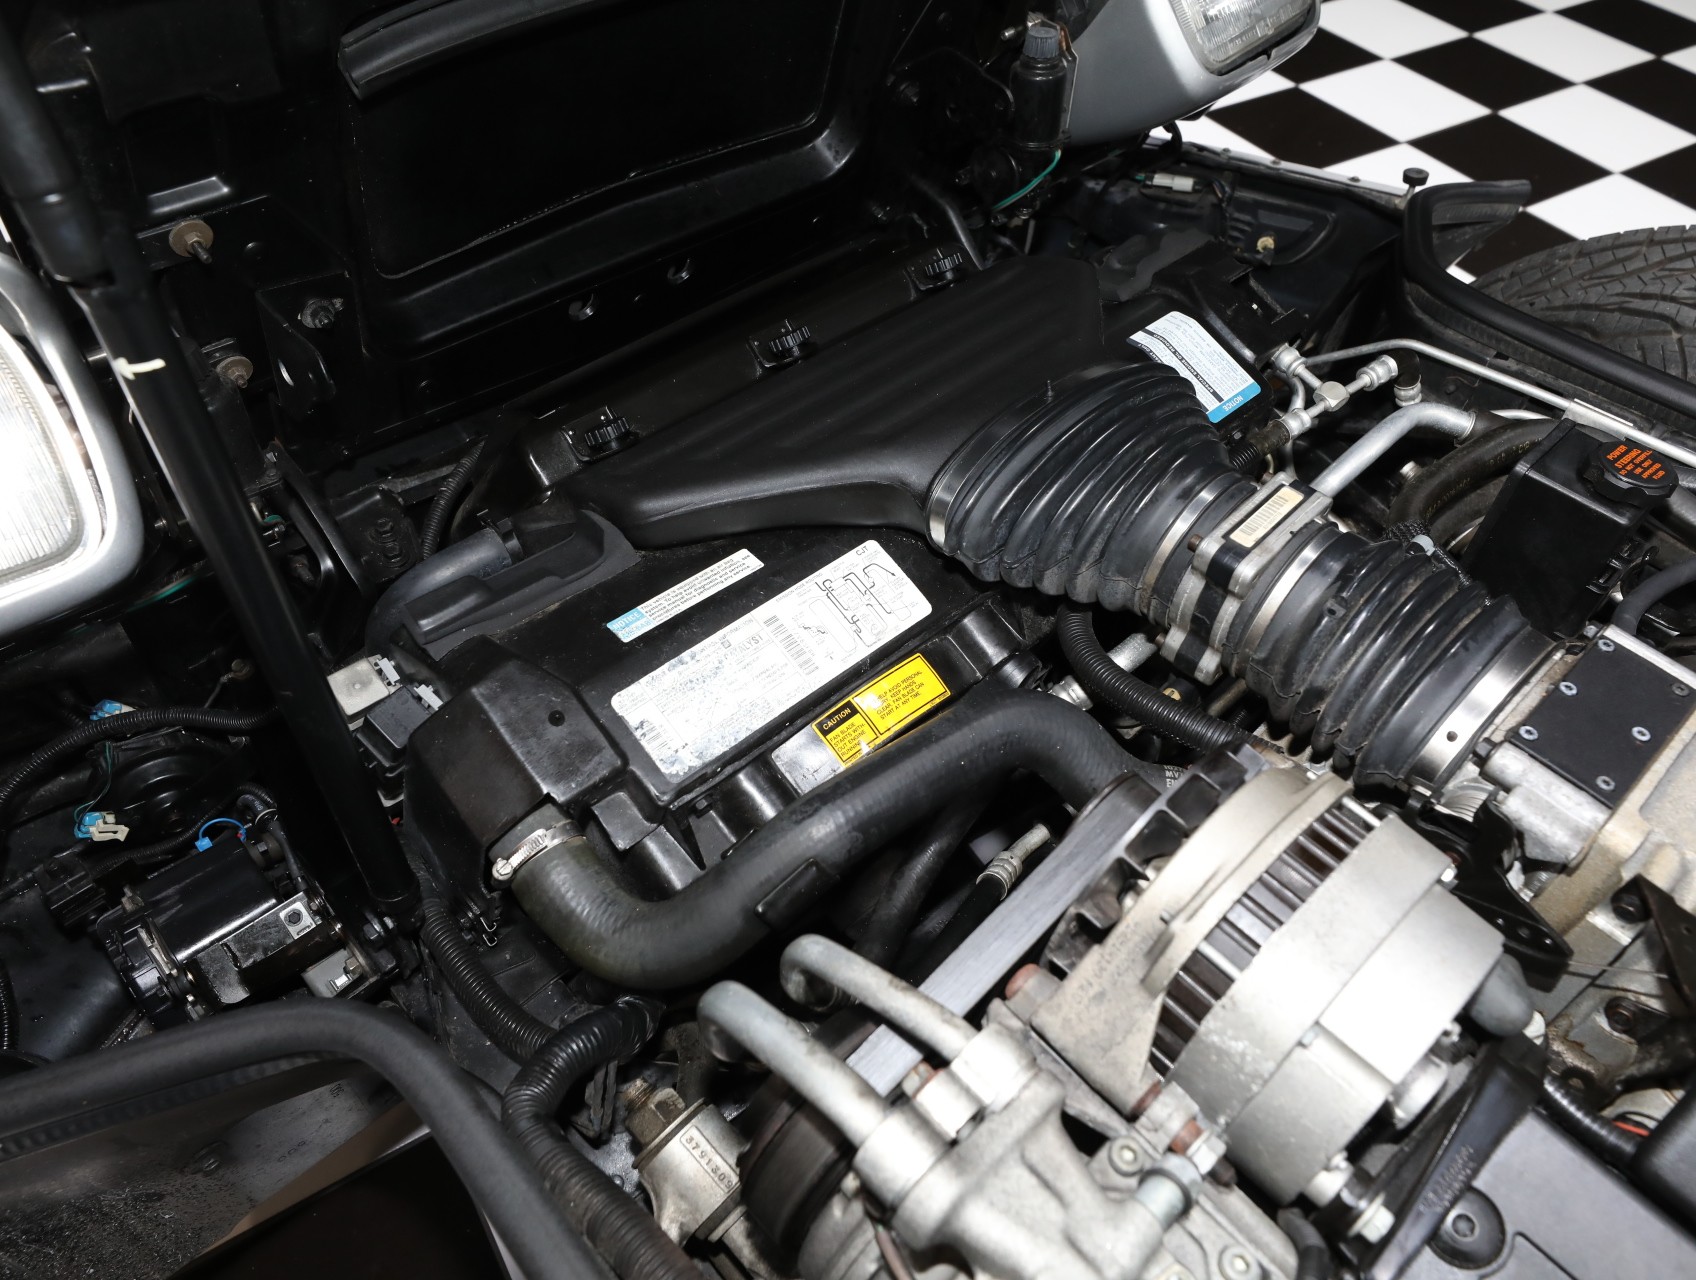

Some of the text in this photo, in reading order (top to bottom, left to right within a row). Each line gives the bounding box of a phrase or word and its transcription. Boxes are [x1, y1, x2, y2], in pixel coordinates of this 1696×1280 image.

[1153, 333, 1175, 352] REQUIRED
[1174, 351, 1182, 359] OIL
[1181, 358, 1197, 375] ENGINE
[1196, 374, 1213, 392] SPECIAL
[1222, 395, 1244, 412] NOTICE
[1606, 444, 1628, 460] POWER
[1615, 449, 1642, 468] STEERING
[855, 545, 870, 556] CJT
[613, 611, 640, 629] NOTICE
[888, 682, 901, 693] AVOID
[900, 670, 922, 684] PERSONAL
[890, 689, 901, 698] KEEP
[902, 680, 916, 691] HANDS
[892, 696, 901, 704] FAN
[902, 688, 914, 698] BLADE
[915, 682, 924, 690] CAN
[822, 707, 851, 730] CAUTION
[880, 708, 894, 720] START
[829, 721, 855, 742] FAN BLADE
[833, 722, 865, 747] STARTS WITH-
[837, 729, 866, 752] OUT ENGINE
